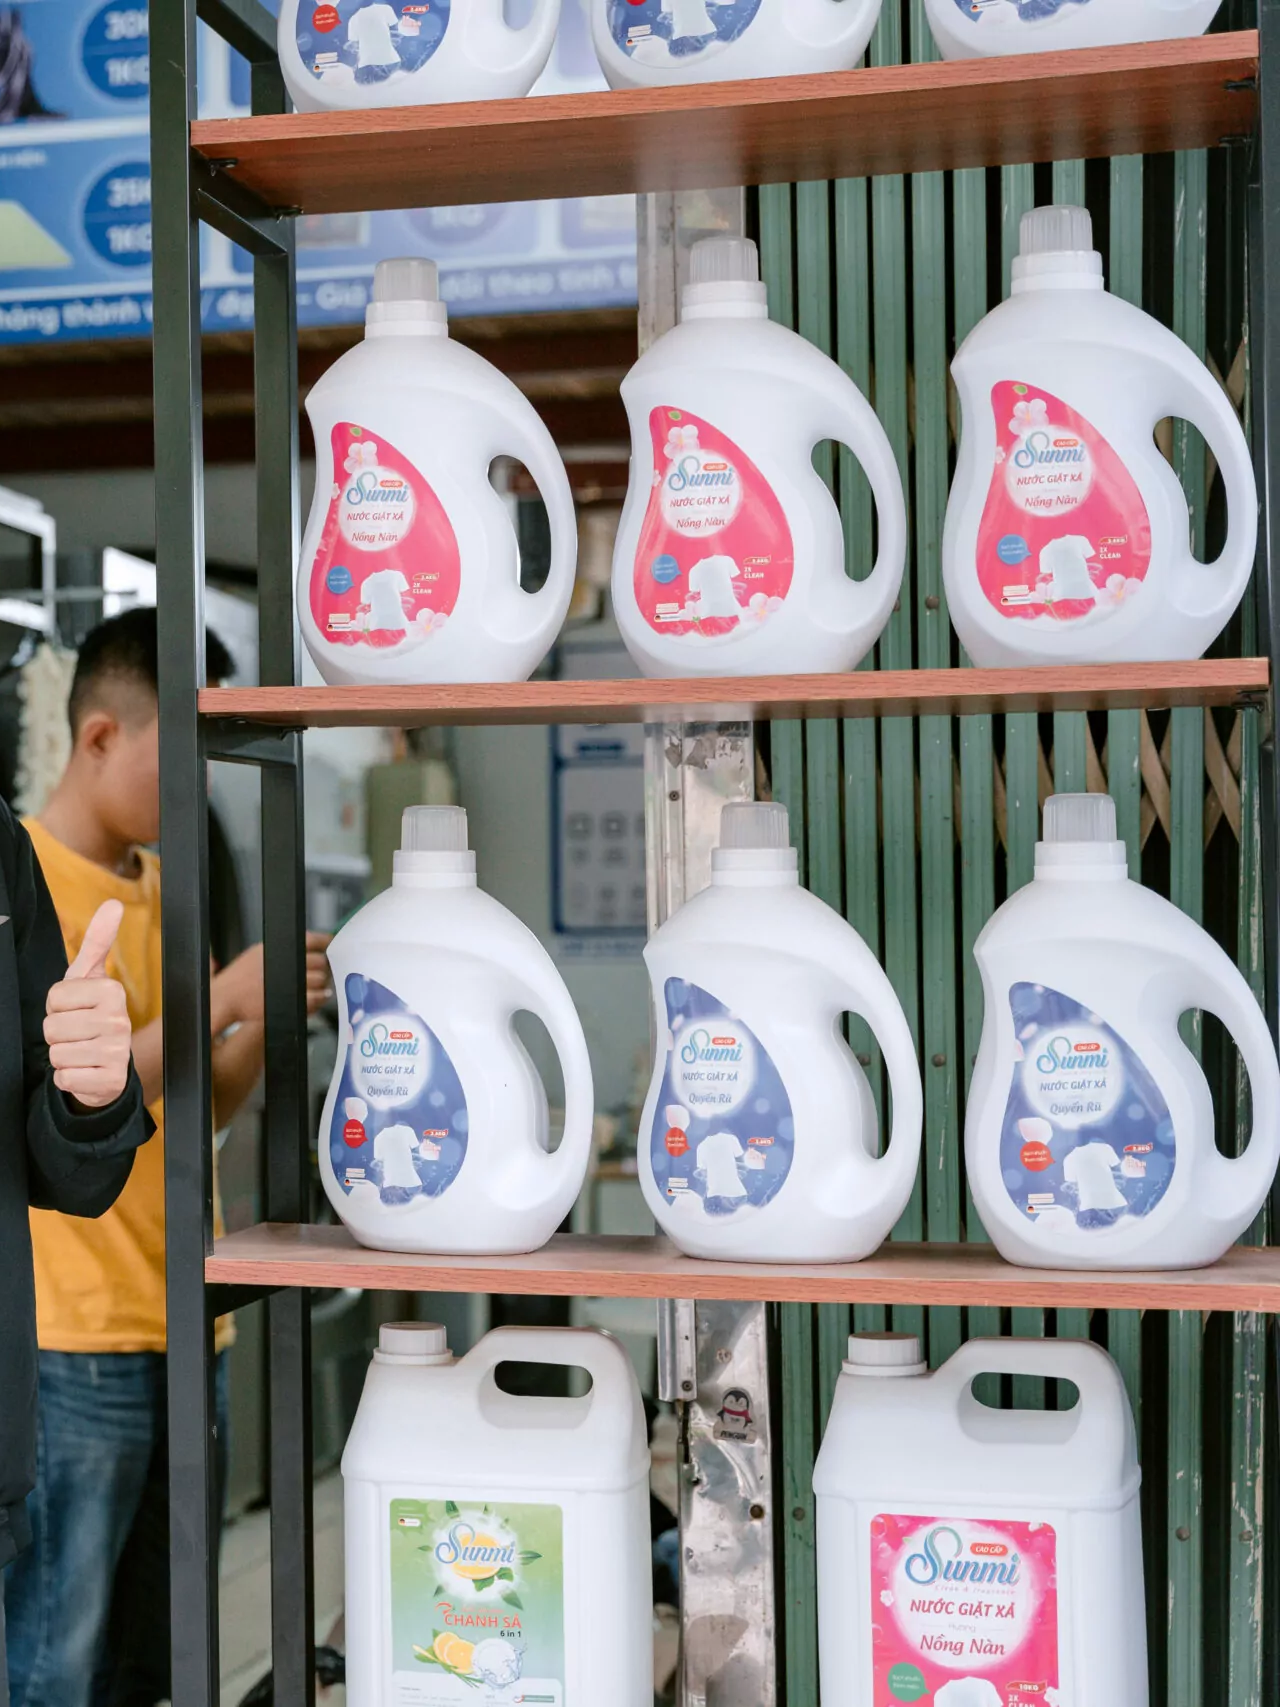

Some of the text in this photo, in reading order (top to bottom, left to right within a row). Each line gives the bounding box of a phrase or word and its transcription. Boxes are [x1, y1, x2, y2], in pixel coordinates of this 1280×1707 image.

[62, 299, 141, 327] thành
[1014, 431, 1086, 469] Sunmi
[669, 455, 735, 491] Sunmi
[1017, 474, 1045, 486] NƯỚC
[346, 471, 410, 506] Sunmi
[347, 511, 371, 521] NƯỚC
[360, 1023, 420, 1058] Sunmi
[681, 1028, 743, 1064] Sunmi
[1036, 1036, 1109, 1074] Sunmi
[361, 1065, 383, 1075] NƯỚC
[682, 1071, 706, 1081] NƯỚC
[1040, 1079, 1069, 1091] NƯỚC
[435, 1522, 516, 1565] Sunmi
[975, 1545, 989, 1553] CAO
[905, 1526, 1020, 1586] Sunmi
[910, 1598, 1015, 1619] NƯỚC GIẶT XẢ
[444, 1613, 499, 1628] CHANH
[500, 1630, 506, 1638] 6
[507, 1630, 515, 1638] in
[920, 1633, 1006, 1656] Nồng Nàn
